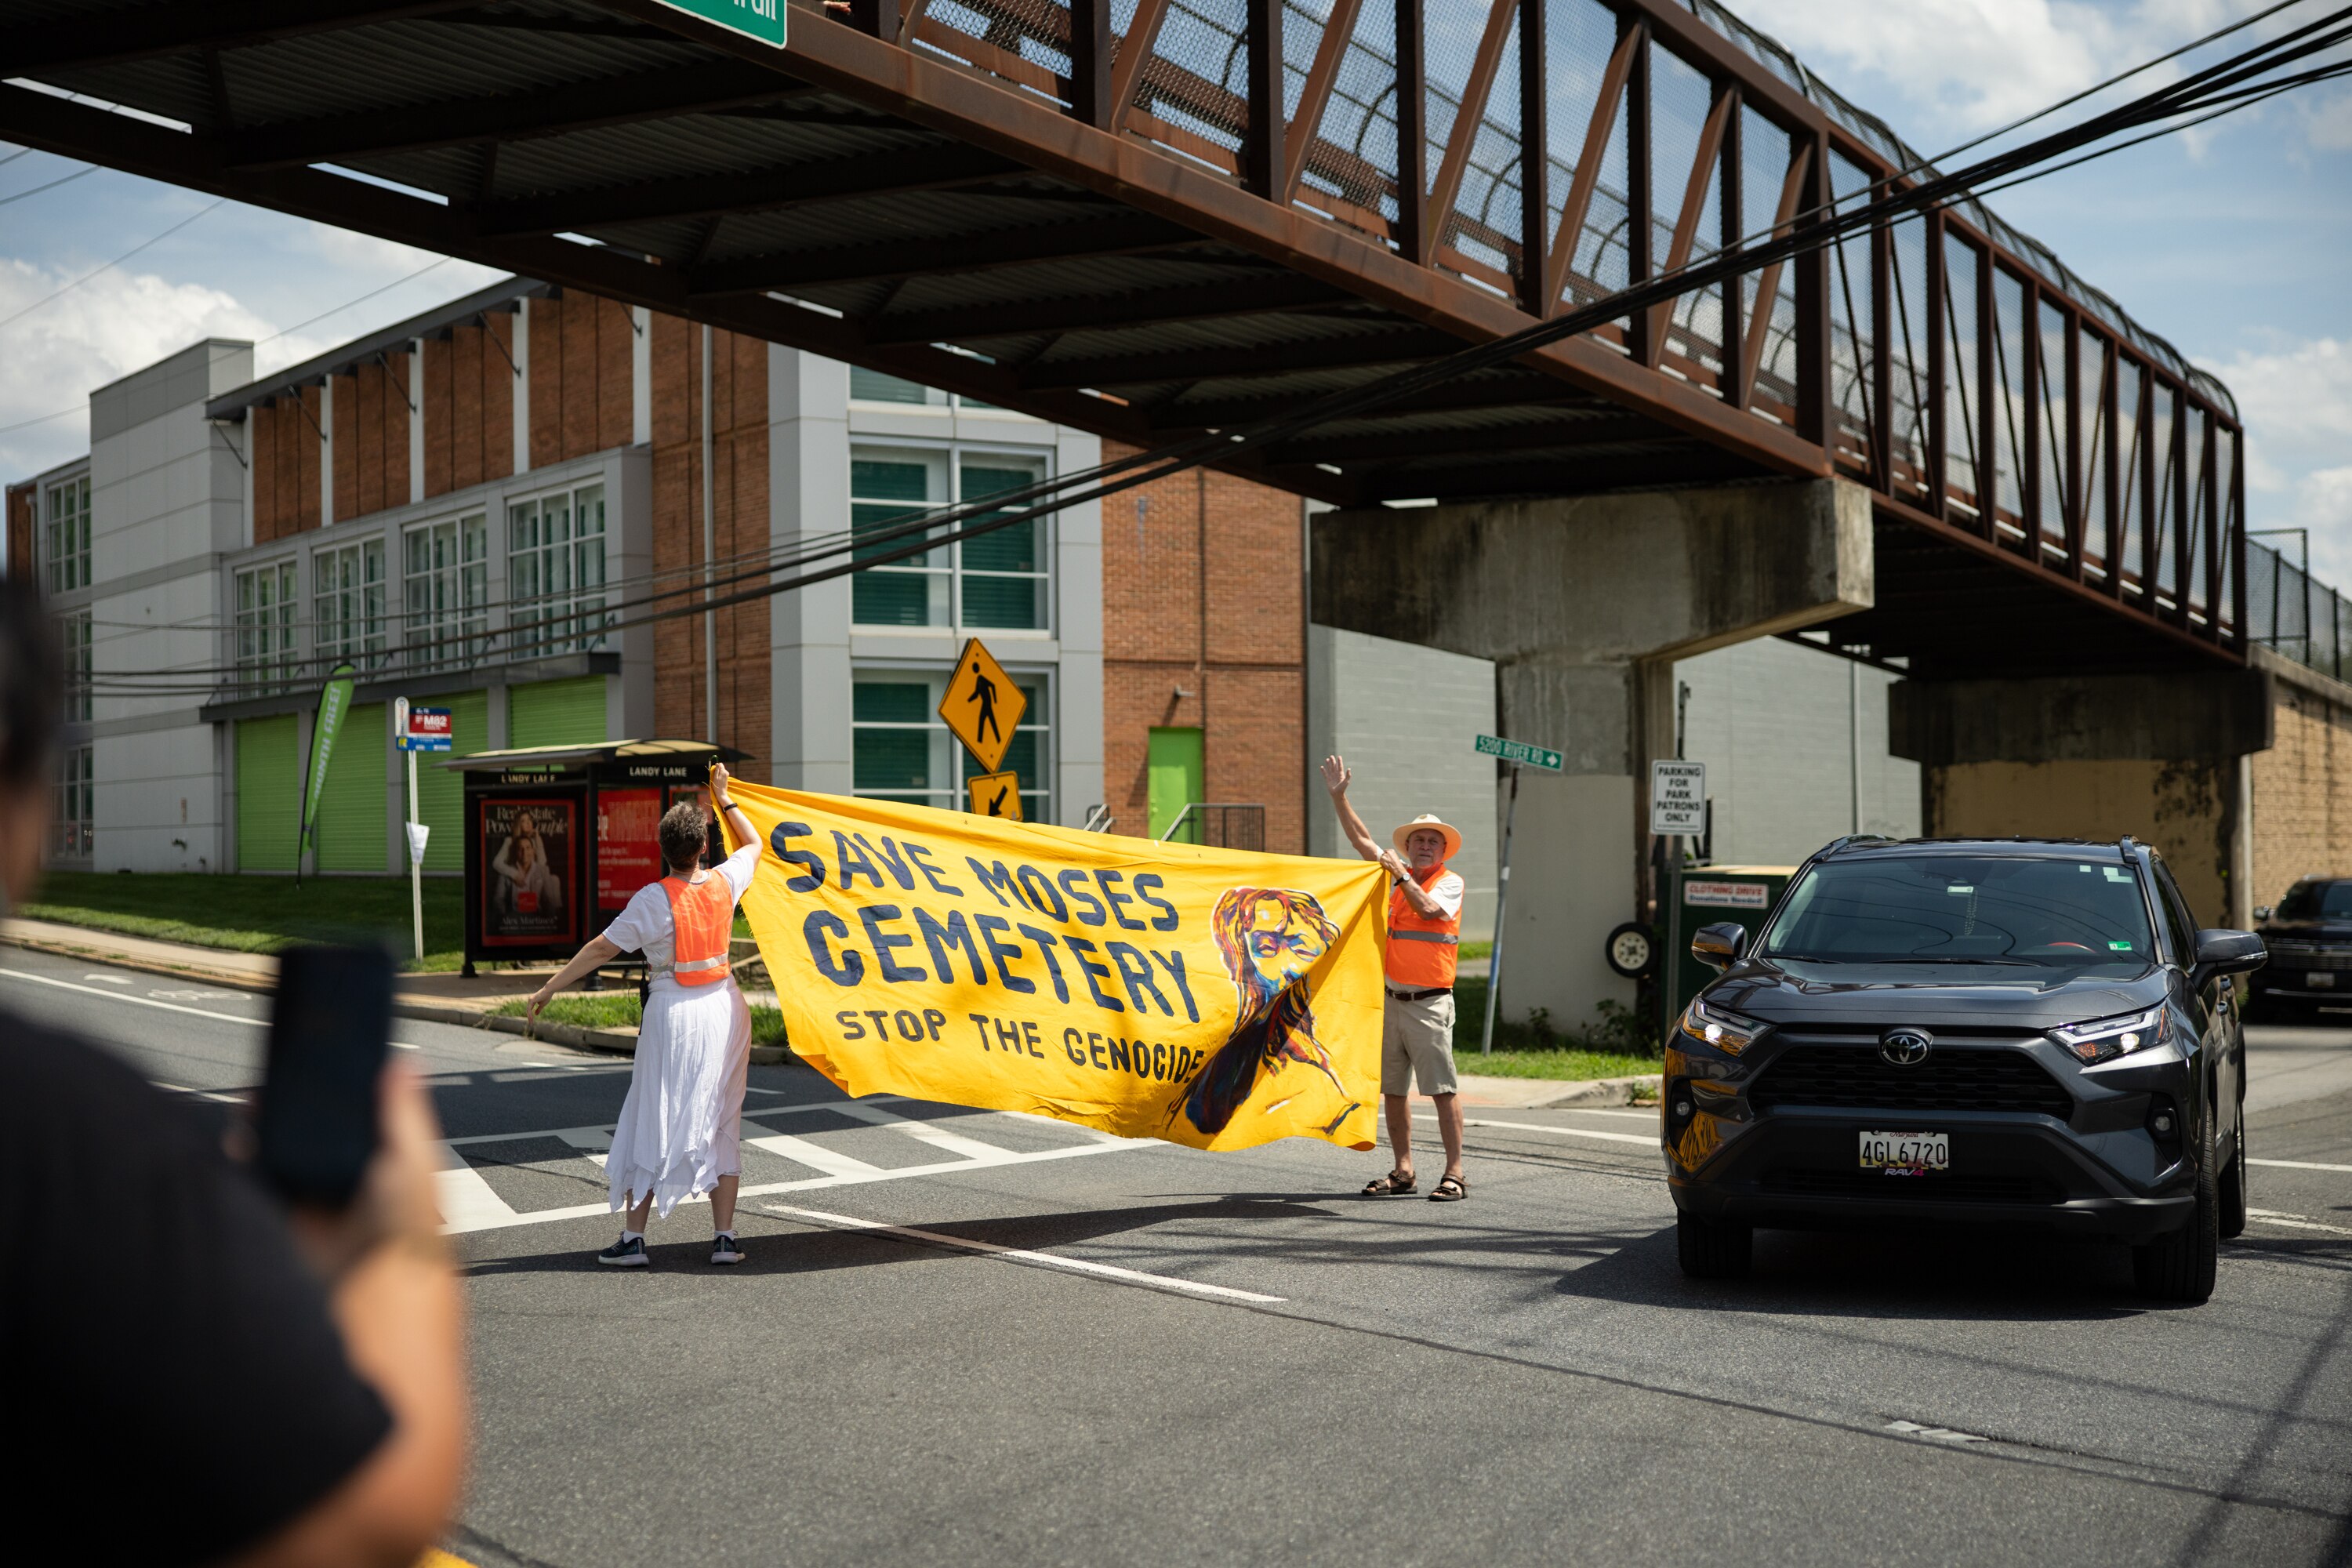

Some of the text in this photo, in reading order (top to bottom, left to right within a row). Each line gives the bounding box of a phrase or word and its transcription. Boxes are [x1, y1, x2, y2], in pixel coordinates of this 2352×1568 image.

[1479, 737, 1544, 764] 5200 RIVER RD
[630, 767, 687, 777] LANDY LANE
[1657, 767, 1700, 777] PARKING
[1668, 778, 1689, 787] FOR
[1665, 789, 1691, 799] PARK
[1656, 800, 1700, 811] PATRONS
[1664, 812, 1691, 822] ONLY
[771, 822, 1178, 931] SAVE MOSES
[1690, 884, 1763, 897] CLOTHING DRIVE
[803, 905, 1200, 1024] CEMETERY
[836, 1009, 1205, 1083] STOP THE GENOCIDE
[1862, 1141, 1946, 1165] 4GL6720
